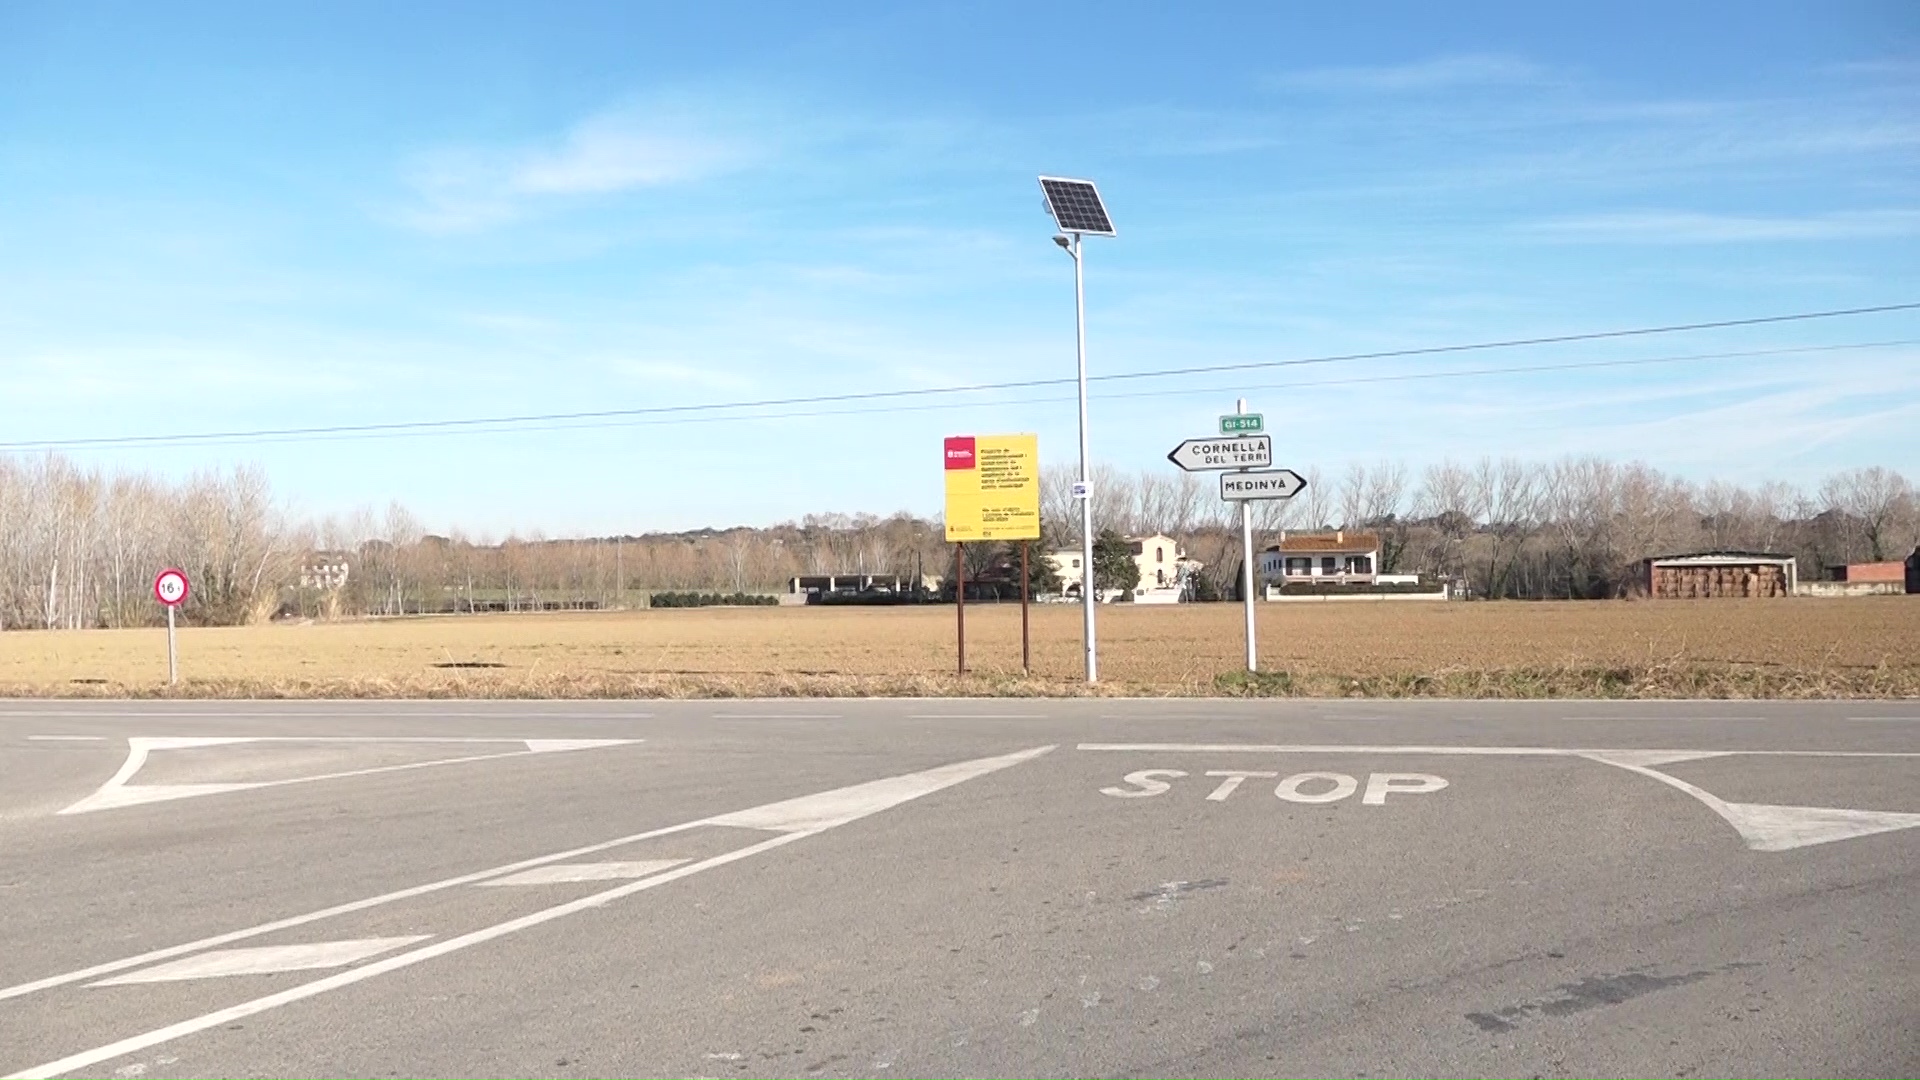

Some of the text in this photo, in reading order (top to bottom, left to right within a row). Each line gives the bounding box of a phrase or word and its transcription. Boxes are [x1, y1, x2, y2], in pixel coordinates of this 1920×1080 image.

[1225, 419, 1258, 428] GI-514
[1192, 440, 1265, 455] CORNELLÀ
[1205, 453, 1267, 464] DEL TERRI
[1225, 478, 1286, 491] MEDINYÀ
[162, 582, 174, 593] 16
[1099, 769, 1450, 805] STOP
